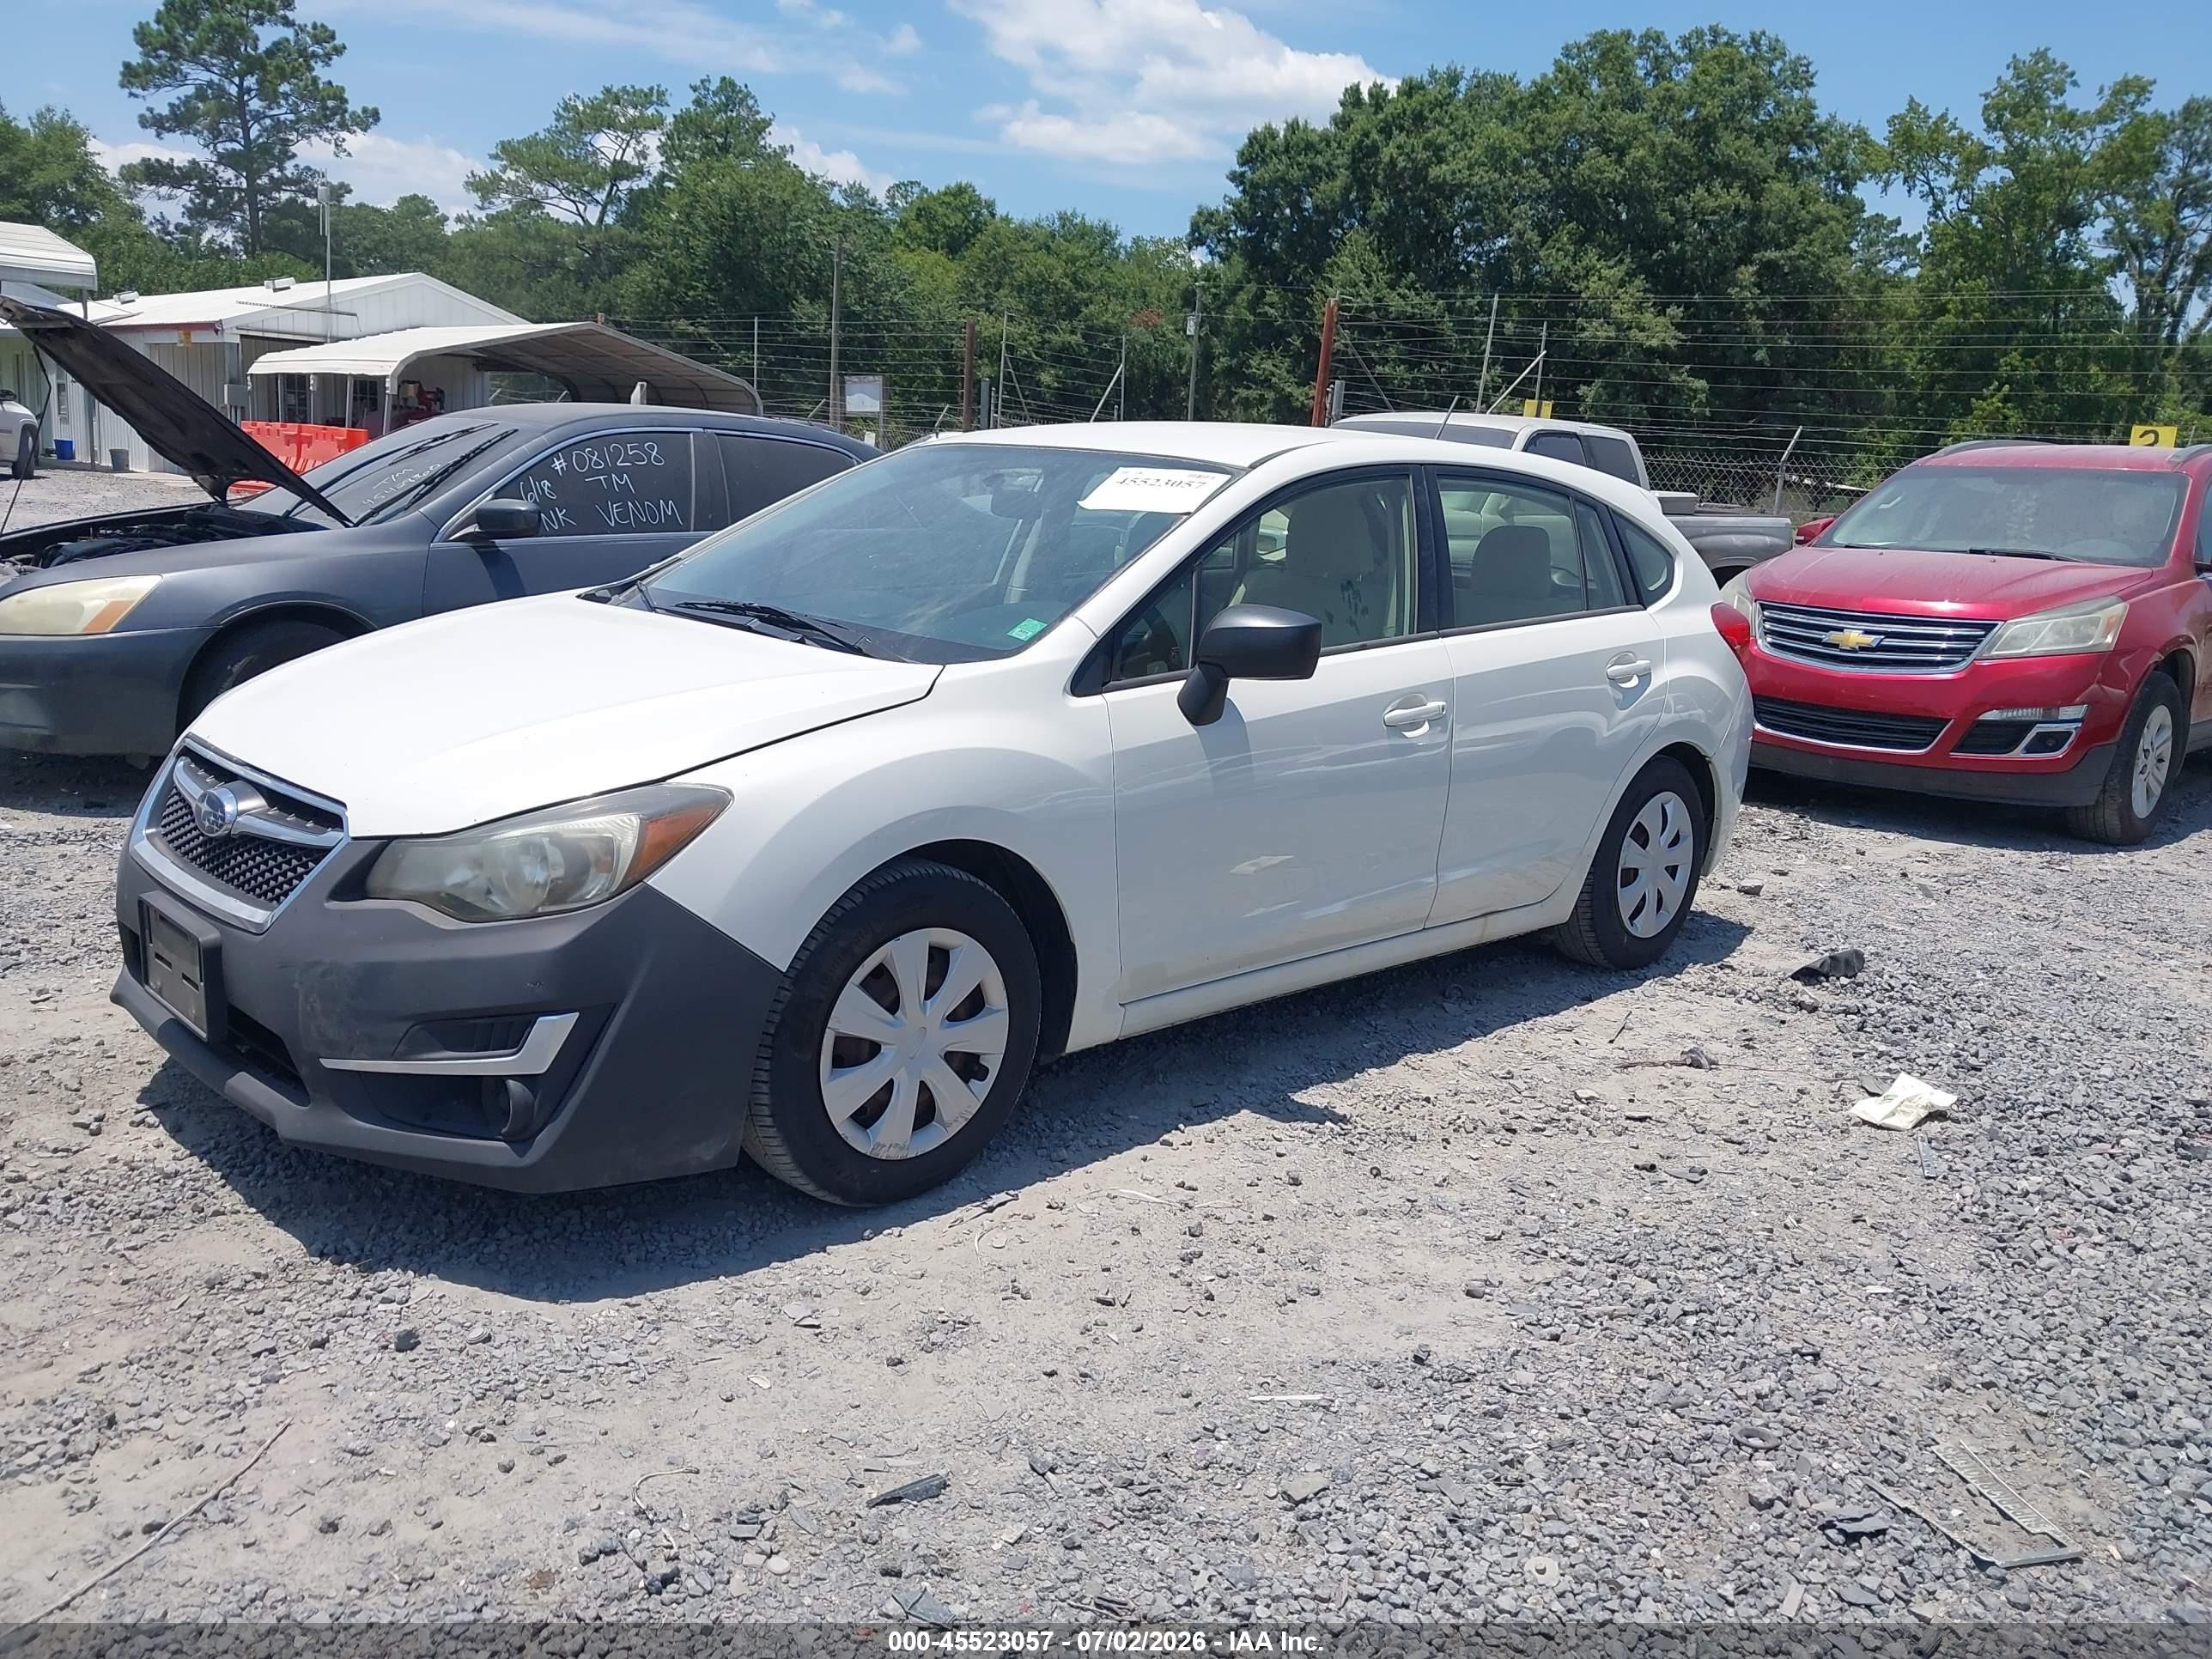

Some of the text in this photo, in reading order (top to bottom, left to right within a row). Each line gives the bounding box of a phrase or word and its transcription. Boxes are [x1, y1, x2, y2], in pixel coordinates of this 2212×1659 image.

[550, 441, 665, 476] #081258
[584, 473, 635, 495] TM
[540, 507, 577, 532] NK
[594, 499, 684, 528] VENOM
